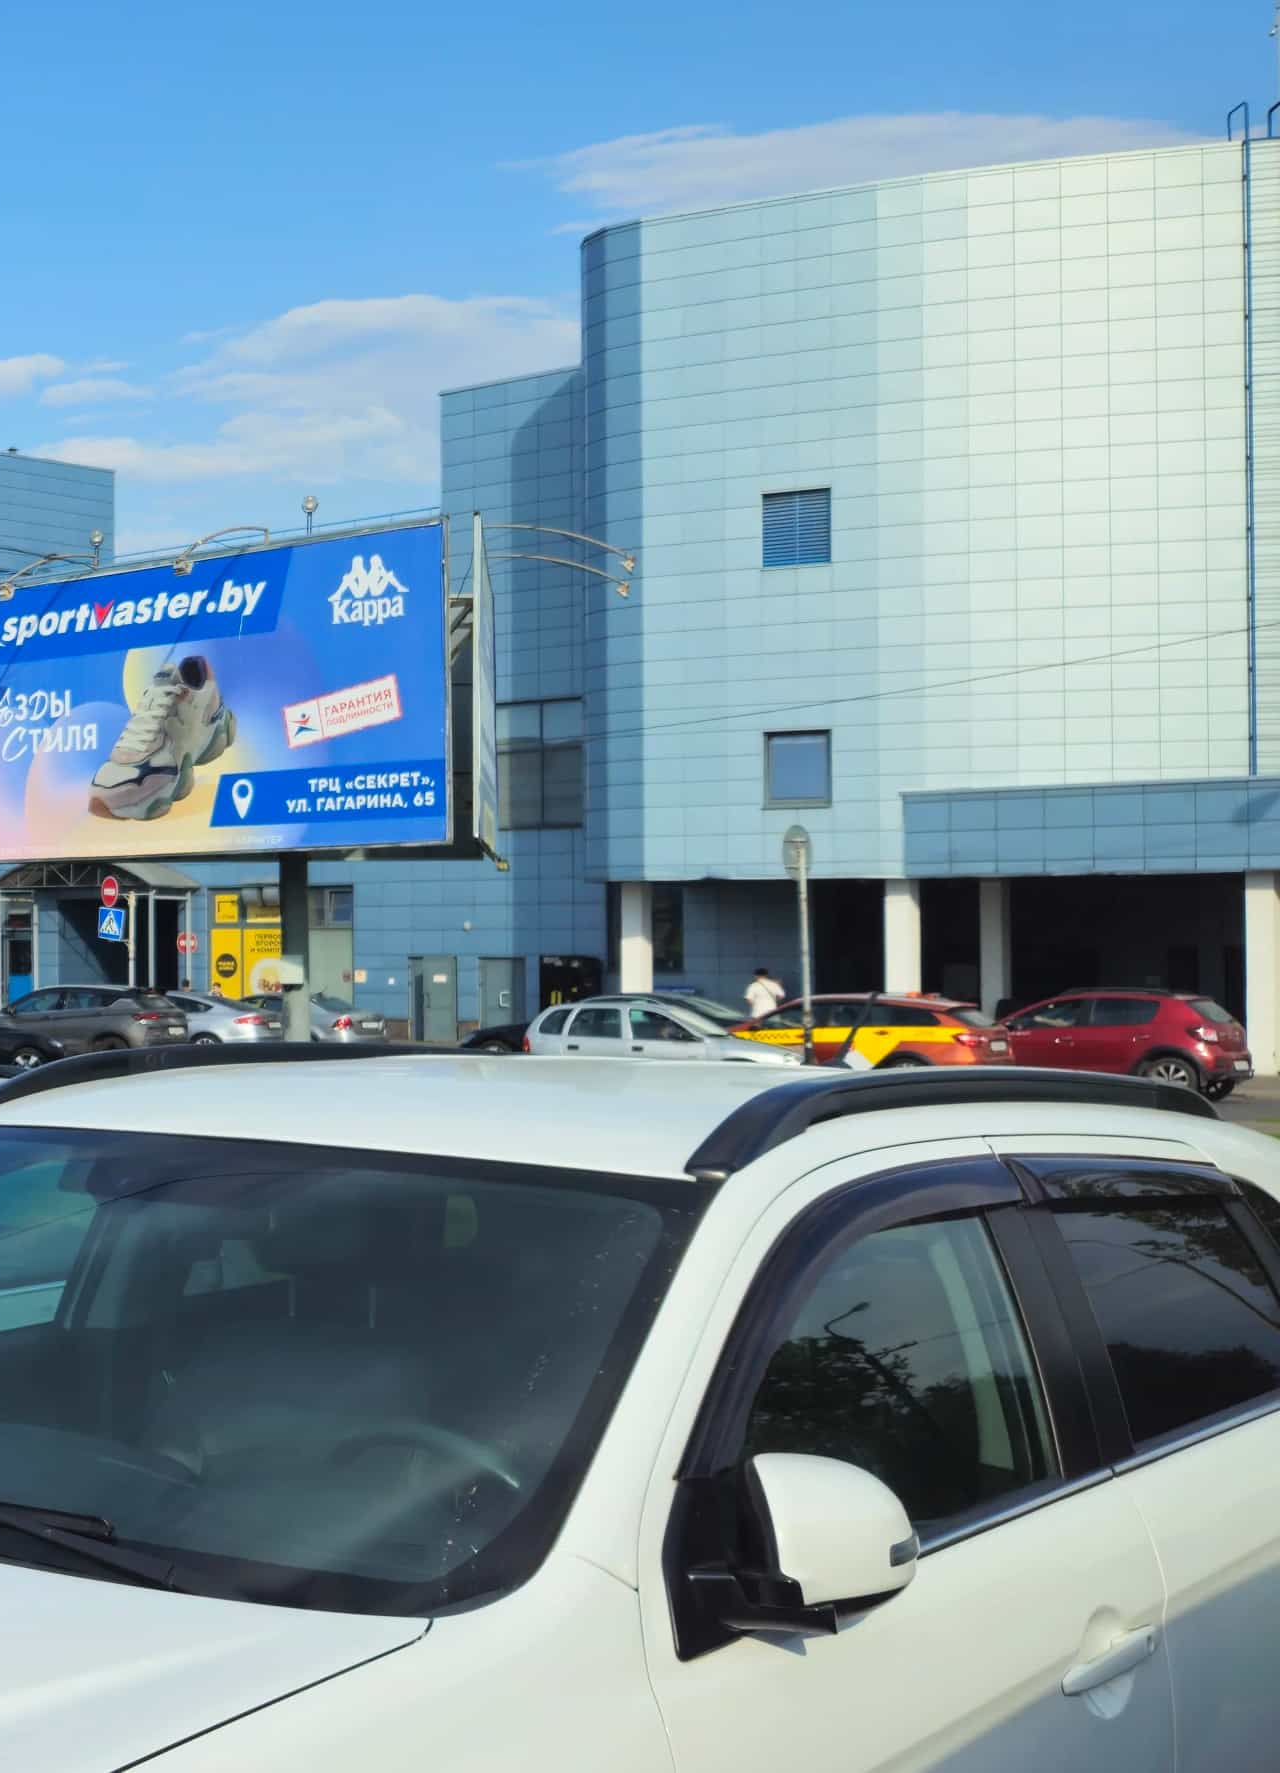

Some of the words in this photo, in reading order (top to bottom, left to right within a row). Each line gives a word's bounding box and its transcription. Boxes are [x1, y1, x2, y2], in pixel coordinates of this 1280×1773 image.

[332, 595, 405, 626] Kappa
[323, 688, 392, 717] ГАРАНТИЯ
[1, 722, 97, 763] СТИЛЯ
[308, 777, 341, 794] ТРЦ
[344, 771, 435, 790] «СЕКРЕТ»,
[286, 798, 312, 813] УЛ.
[316, 793, 408, 812] ГАГАРИНА,
[412, 790, 435, 807] 65
